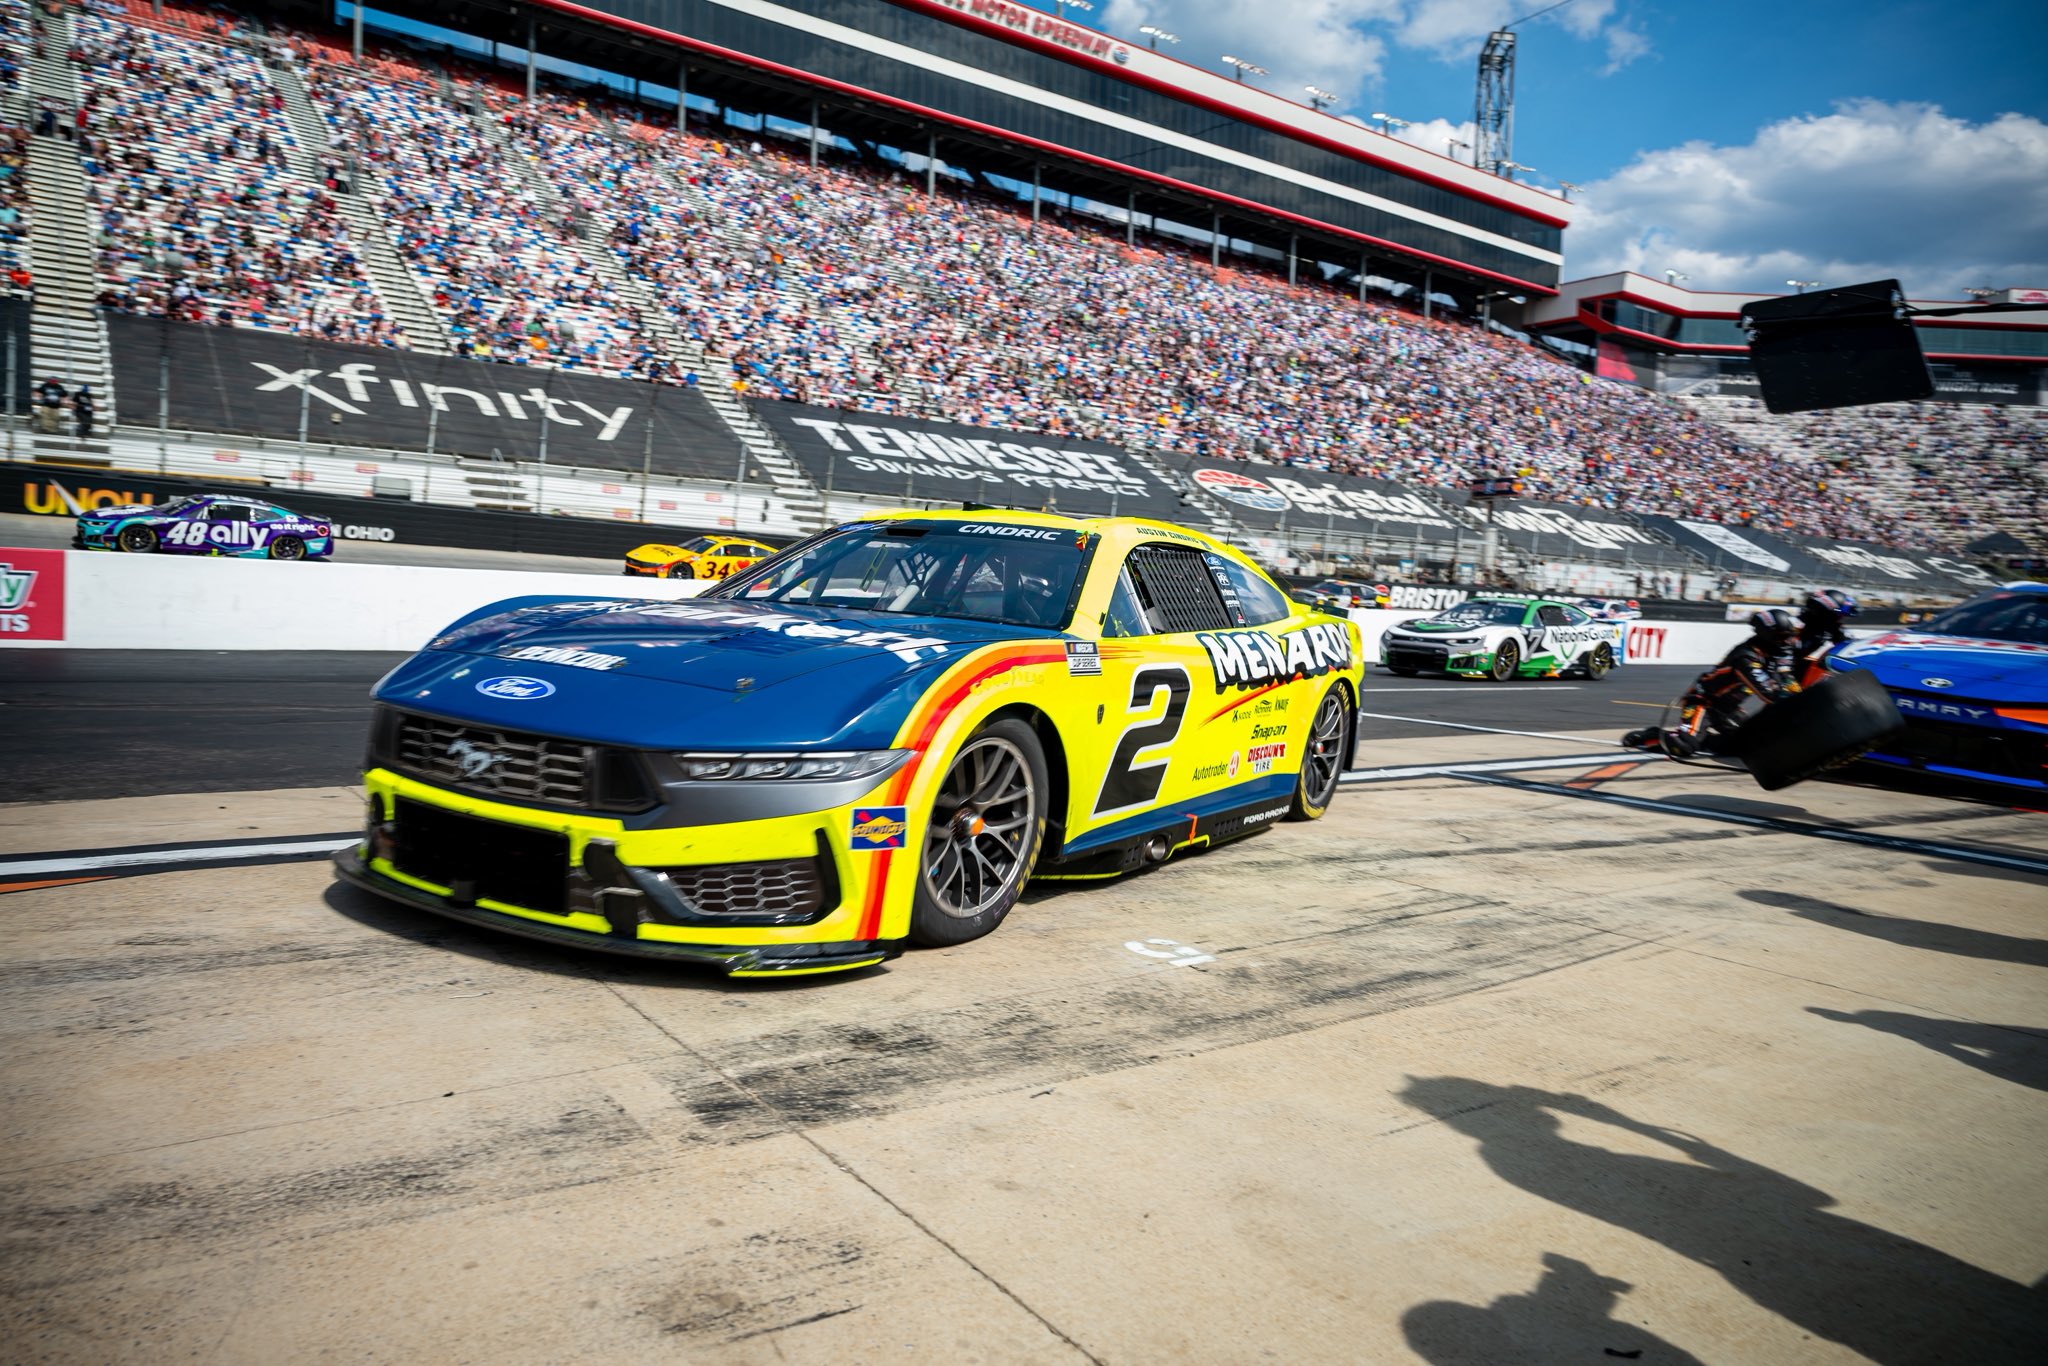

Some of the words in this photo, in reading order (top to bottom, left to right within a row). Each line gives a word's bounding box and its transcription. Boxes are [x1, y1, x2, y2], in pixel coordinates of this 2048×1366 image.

[969, 0, 1030, 30] MOTOR
[1031, 15, 1114, 57] SPEEDWAY
[250, 362, 634, 441] xfinity
[790, 417, 1147, 485] TENNESSEE
[846, 455, 1004, 484] SOUNDS
[1007, 473, 1152, 498] PERFECT
[1265, 477, 1441, 518] Bristol
[167, 521, 208, 547] 48
[209, 520, 271, 552] ally
[344, 524, 396, 542] OHIO
[957, 524, 1063, 542] CINDRIC
[1135, 527, 1168, 538] AUSTIN
[1167, 531, 1200, 544] CINDRIC
[701, 561, 732, 580] 34
[1390, 585, 1468, 610] BRISTOL
[1200, 622, 1351, 684] MENARDS
[1527, 628, 1546, 663] 7
[1627, 627, 1668, 659] CITY
[509, 645, 627, 671] PENNZOIL
[484, 677, 545, 697] Ford
[1895, 697, 1989, 719] AMRY
[1090, 662, 1192, 821] 2
[1250, 724, 1288, 741] Snap-on
[1247, 743, 1286, 763] DISCOUNT
[1191, 761, 1229, 782] Autotrader
[1254, 761, 1271, 773] TIRE
[1243, 812, 1265, 825] FORD
